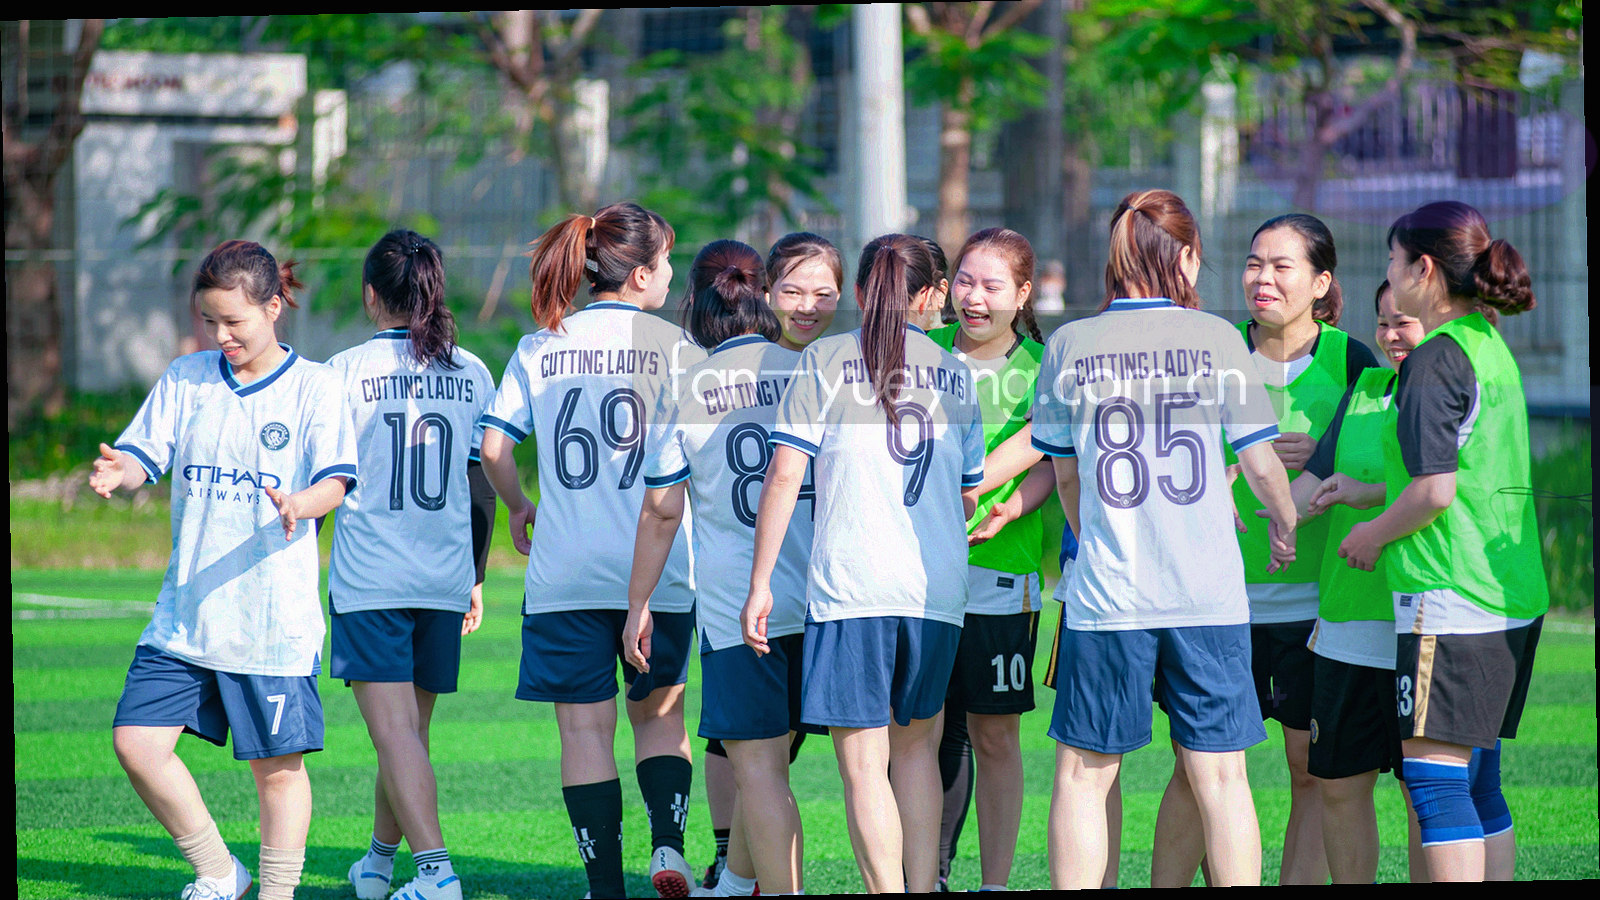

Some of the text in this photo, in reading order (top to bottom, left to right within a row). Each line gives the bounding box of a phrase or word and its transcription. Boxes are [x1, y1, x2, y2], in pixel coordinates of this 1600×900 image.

[540, 349, 659, 379] CUTTING LADYS
[915, 364, 965, 401] LADYS
[1075, 348, 1212, 387] CUTTING LADYS
[361, 375, 474, 403] CUTTING LADYS
[703, 380, 774, 416] CUTTING
[554, 387, 648, 490] 69
[885, 400, 935, 507] 9
[1094, 391, 1208, 510] 85
[182, 464, 282, 490] ETIHAD
[383, 412, 454, 512] 10
[186, 487, 261, 505] AIRWAYS
[991, 653, 1027, 692] 10
[266, 694, 287, 736] 7
[1396, 674, 1414, 718] 3
